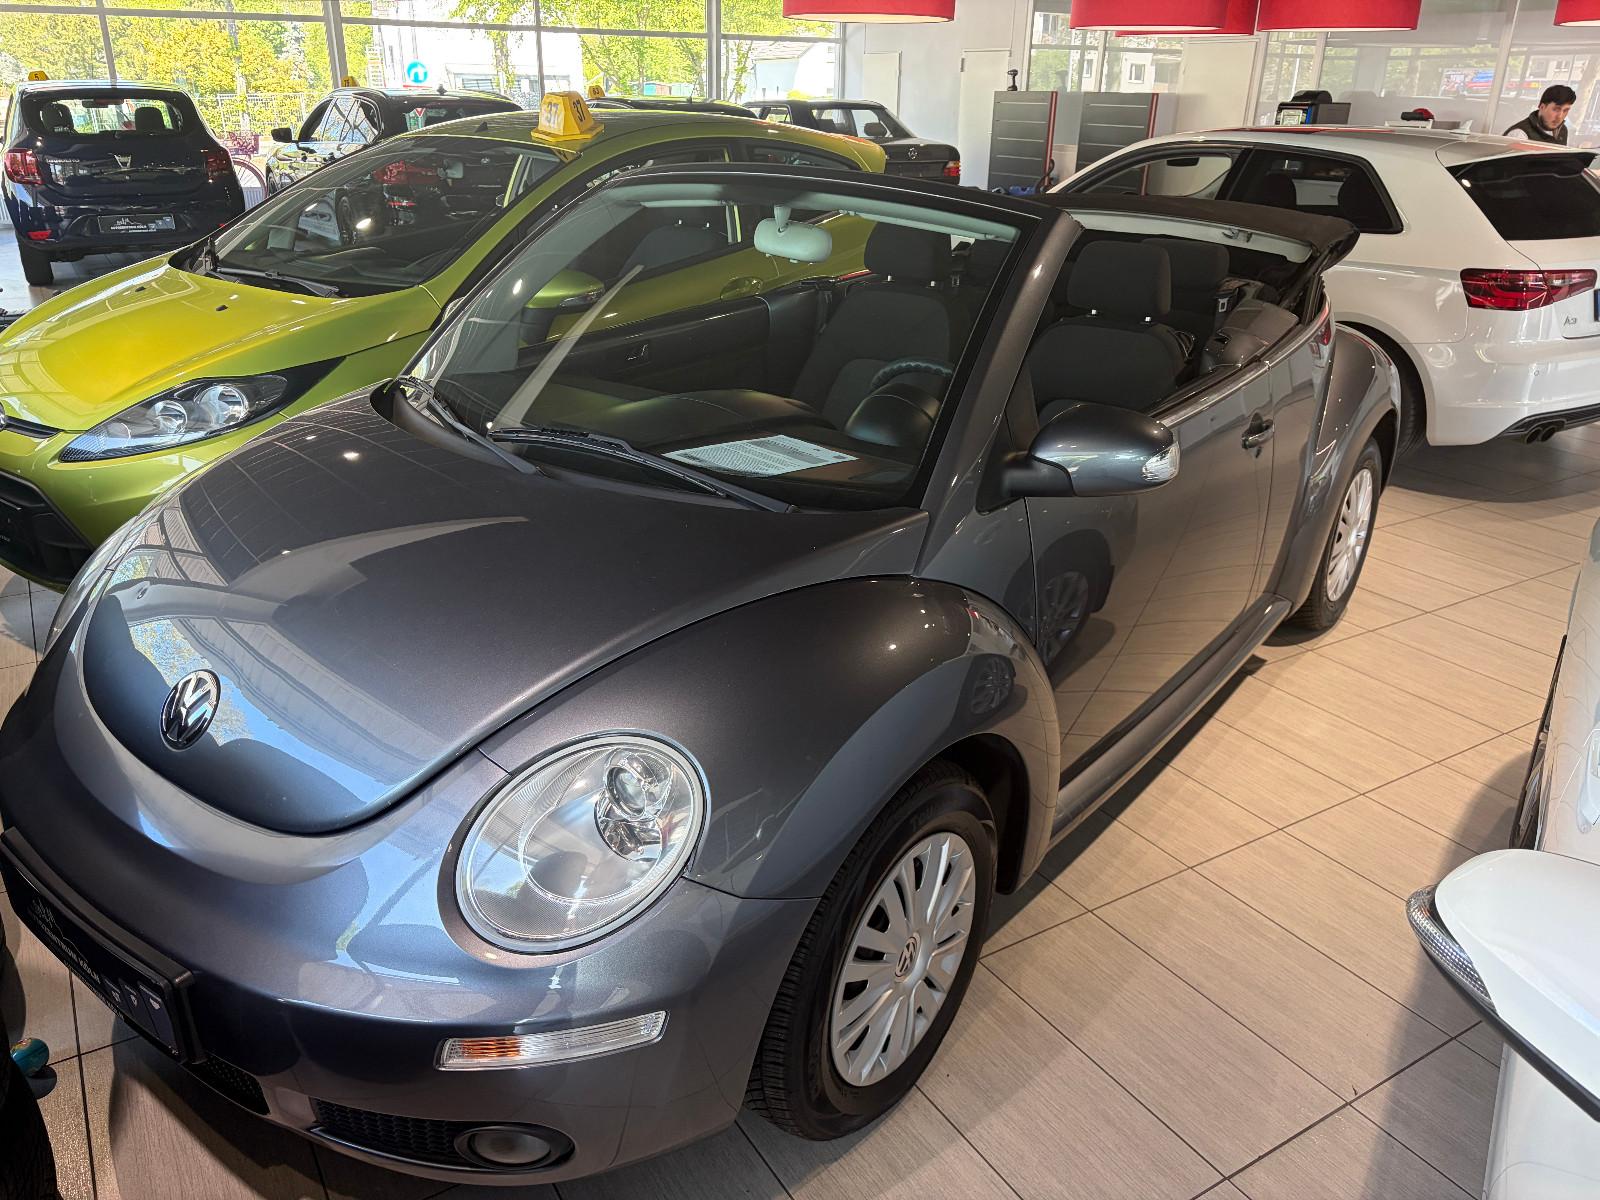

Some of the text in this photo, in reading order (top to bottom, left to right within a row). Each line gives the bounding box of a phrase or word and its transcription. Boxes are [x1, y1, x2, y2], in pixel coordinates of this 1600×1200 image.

[546, 101, 559, 128] 37
[573, 99, 586, 122] 37
[1563, 315, 1577, 326] A3
